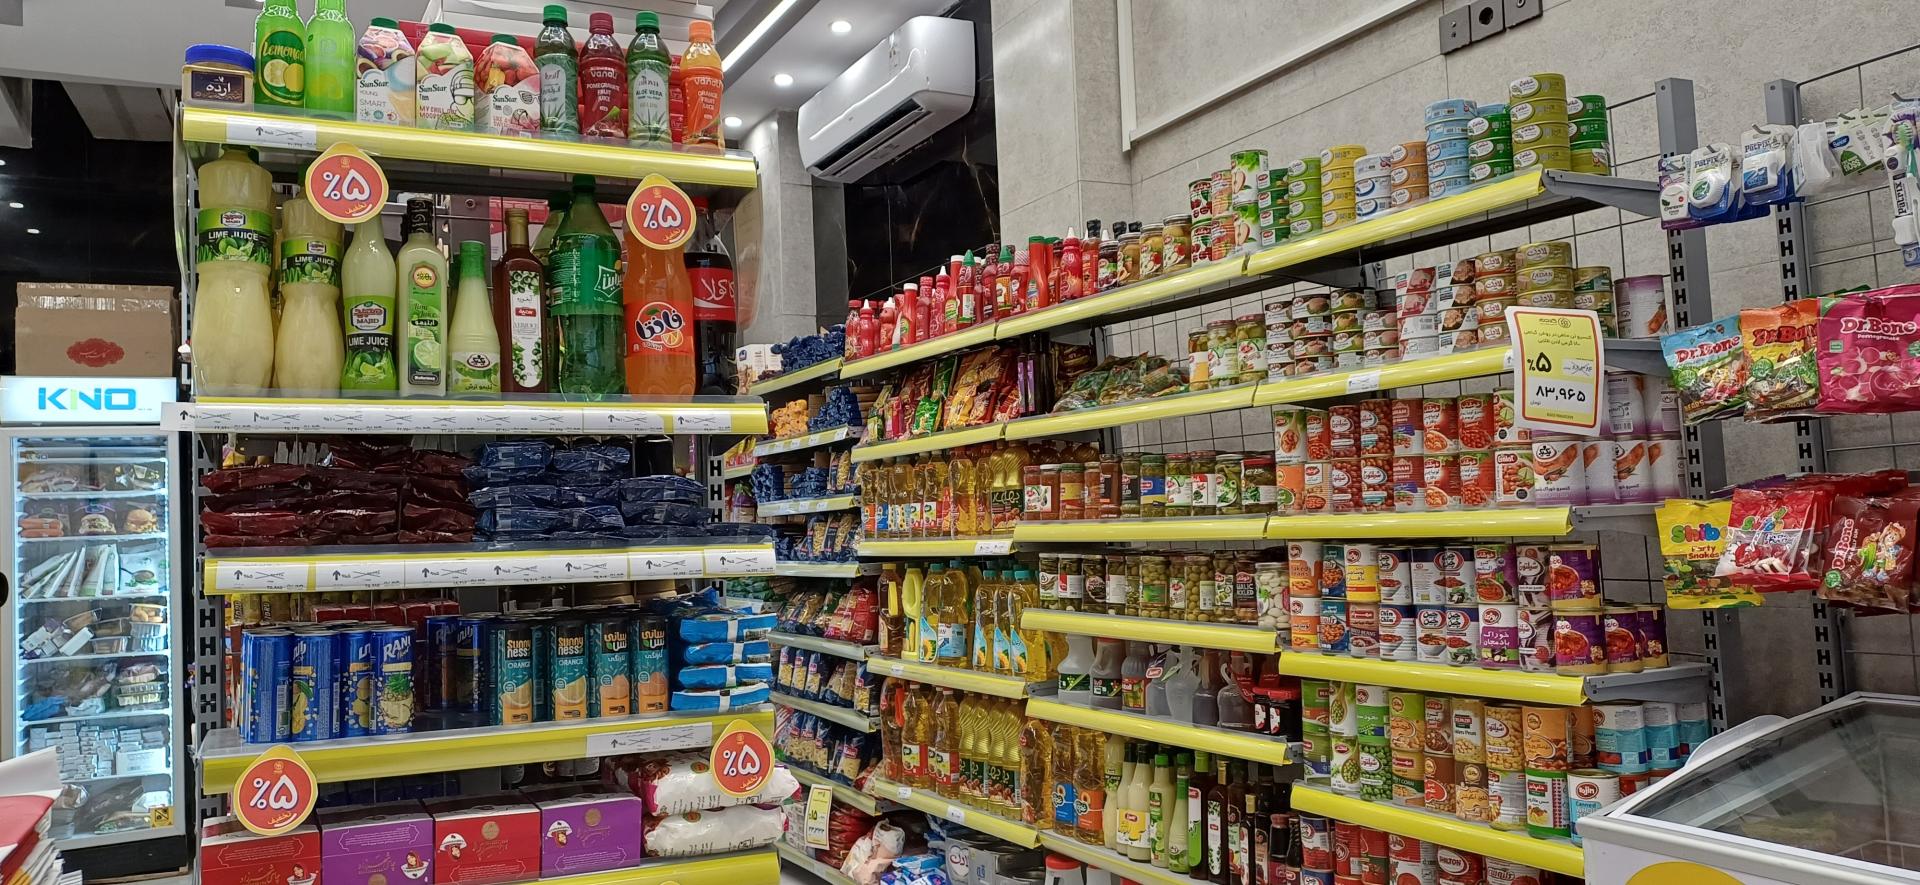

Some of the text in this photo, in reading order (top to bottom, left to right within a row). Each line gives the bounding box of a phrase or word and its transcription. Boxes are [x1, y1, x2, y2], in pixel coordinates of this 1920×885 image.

[360, 79, 389, 88] SunStar
[419, 84, 447, 93] SunStar
[208, 230, 260, 241] LIME JUICE
[315, 257, 335, 266] JUICE
[635, 308, 684, 340] فانتا
[366, 336, 388, 346] JUICE
[1691, 545, 1716, 554] Party
[1688, 551, 1719, 560] Snakes
[436, 623, 457, 645] RAN
[1483, 638, 1510, 646] بادمجان
[383, 636, 411, 662] RANI
[507, 648, 528, 658] ness
[558, 646, 579, 655] ness
[559, 657, 584, 666] ORANGE
